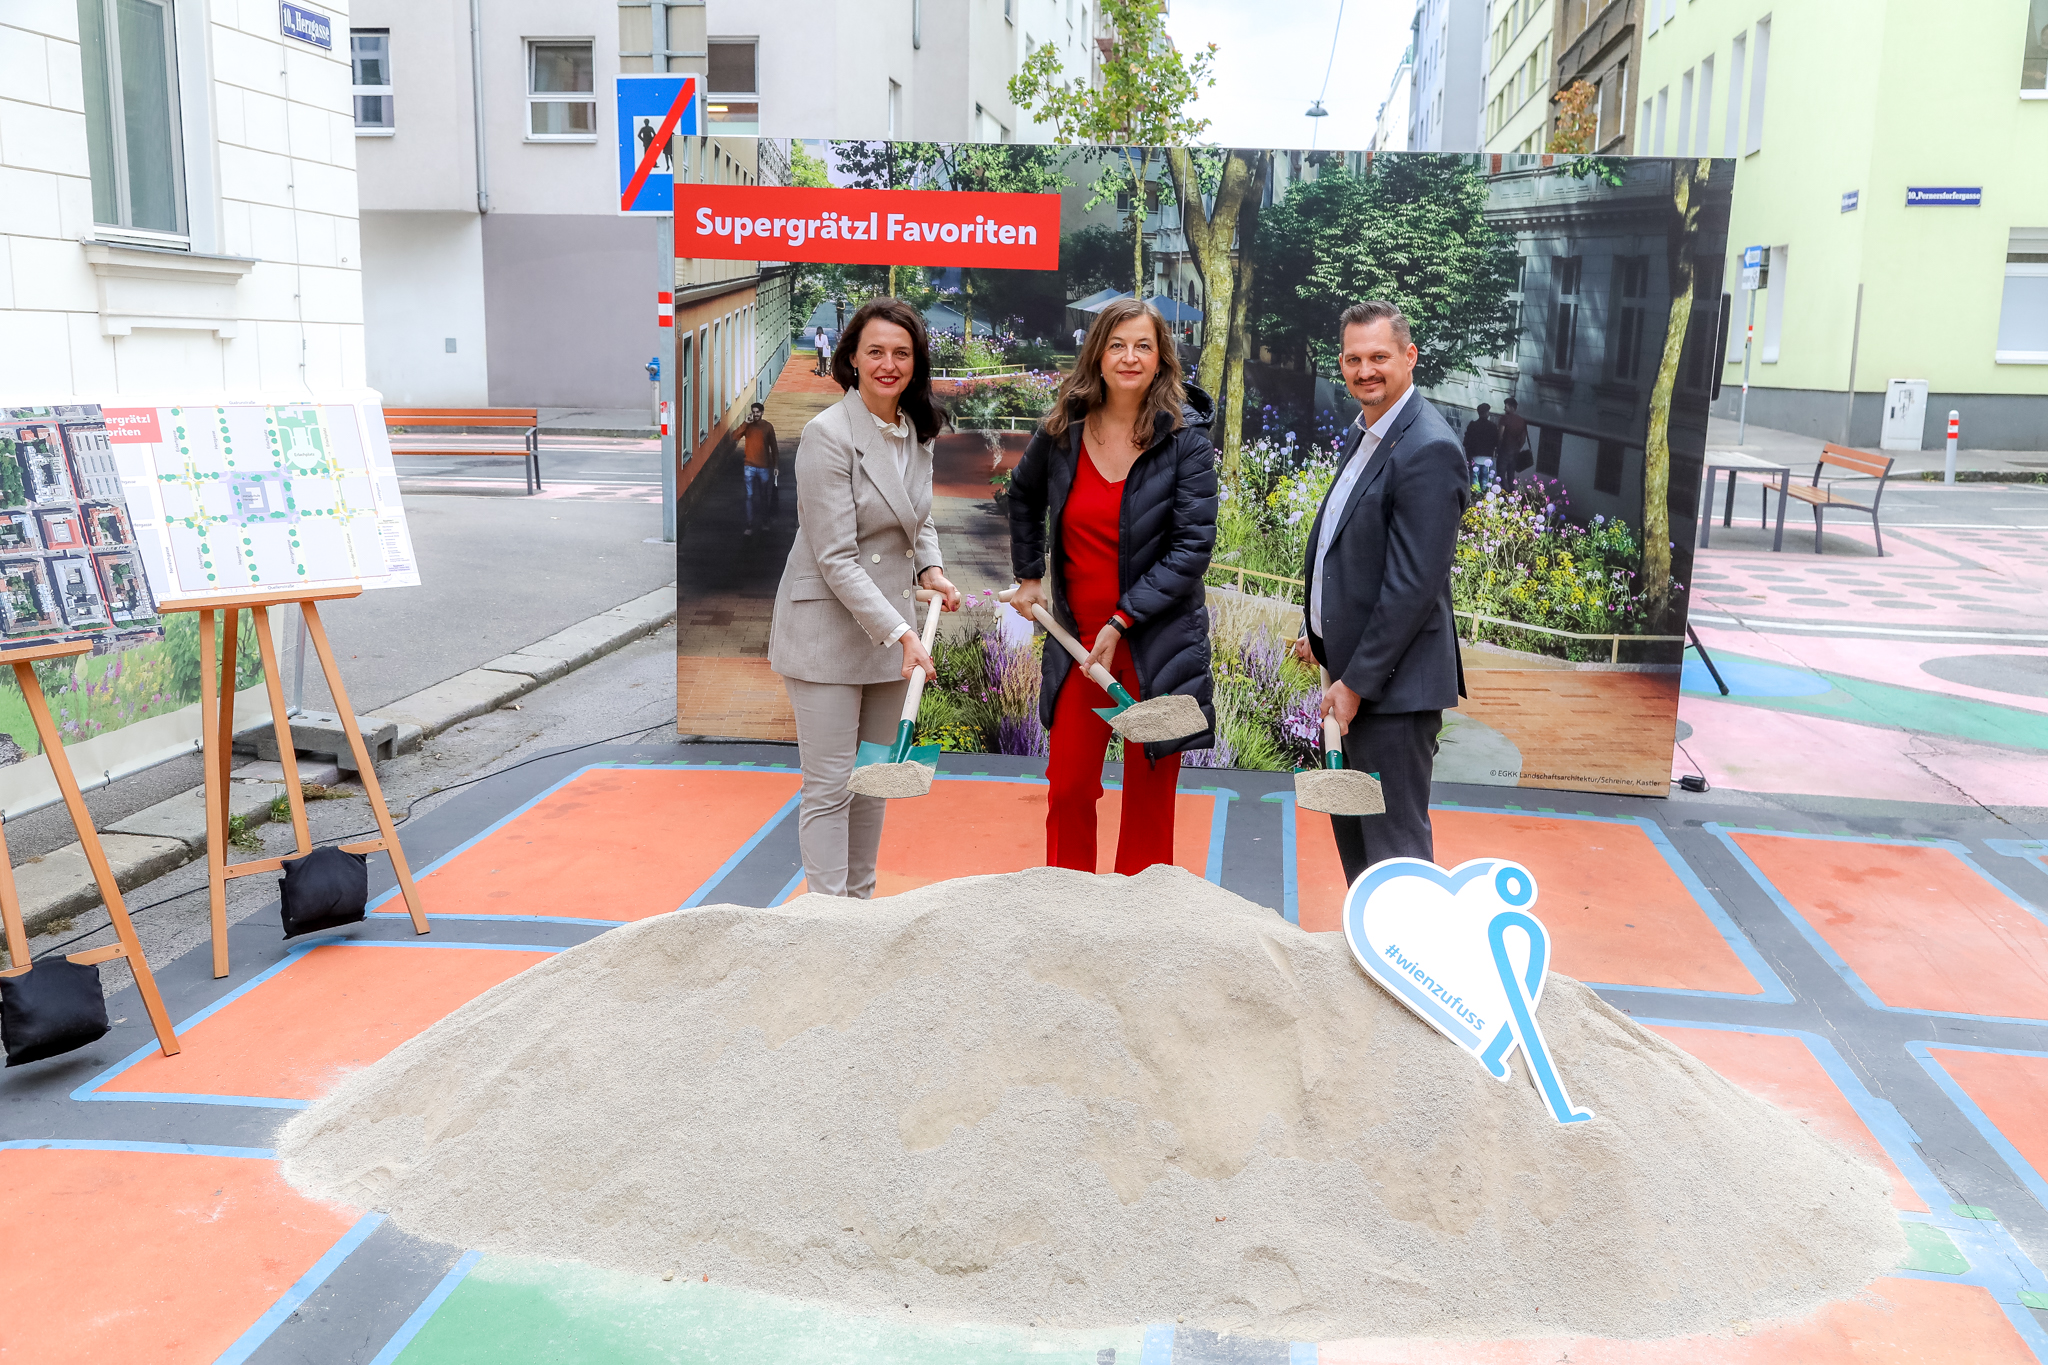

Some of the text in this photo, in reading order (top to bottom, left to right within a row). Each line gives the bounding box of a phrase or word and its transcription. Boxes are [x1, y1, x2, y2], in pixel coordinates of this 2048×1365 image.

[295, 10, 330, 41] Herzgasse
[696, 207, 1036, 246] Supergrätzl Favoriten
[105, 414, 150, 426] ergrätzl
[107, 428, 141, 436] oriten
[1520, 772, 1634, 786] Landschaftsarchitektur/Schreiner,
[1385, 944, 1485, 1030] #wienzufuss
